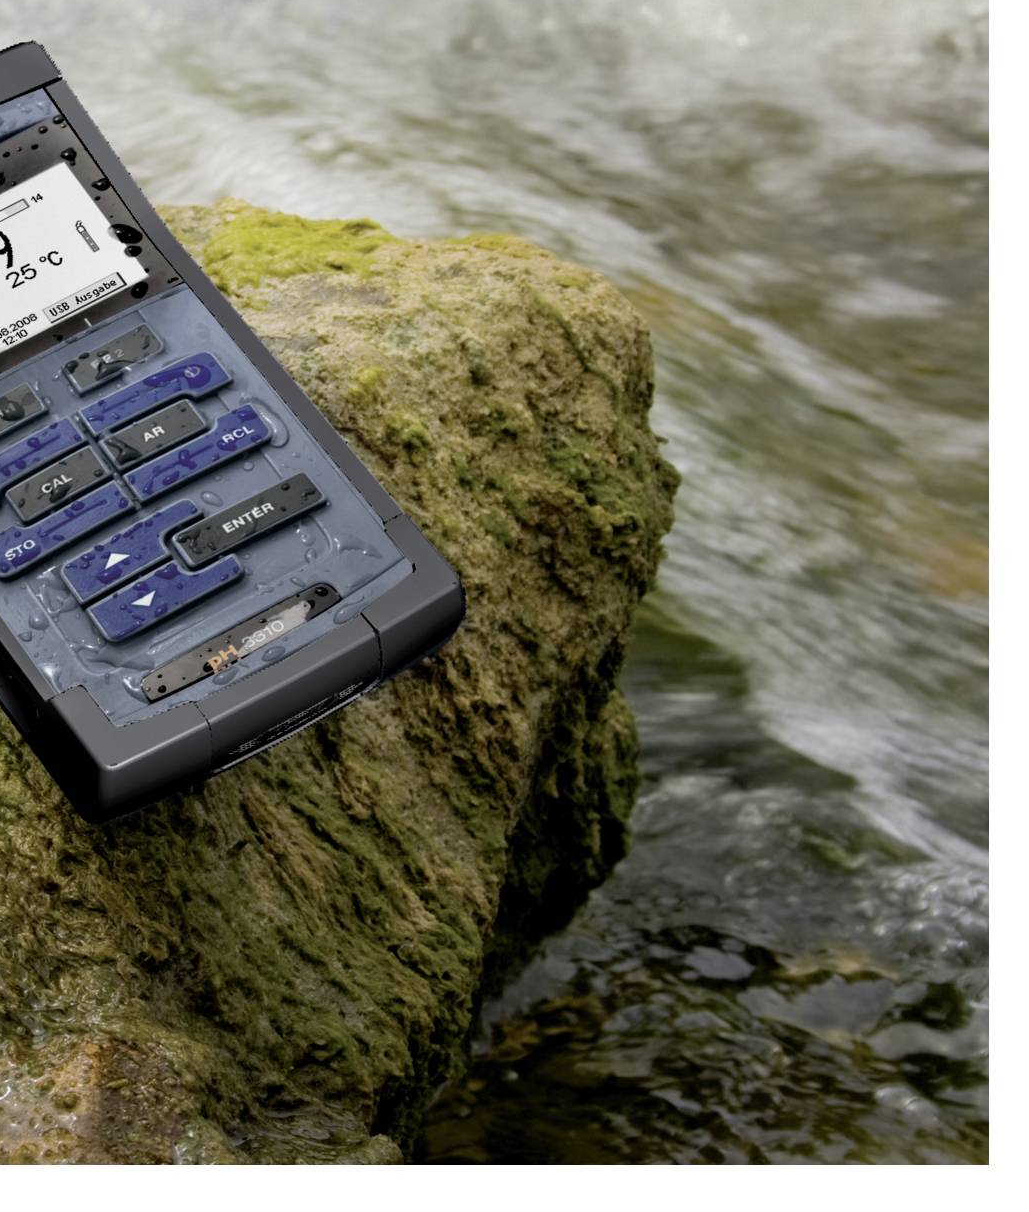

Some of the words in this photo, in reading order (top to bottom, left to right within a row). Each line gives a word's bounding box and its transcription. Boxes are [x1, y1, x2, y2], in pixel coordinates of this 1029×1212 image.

[30, 193, 44, 204] 14
[5, 263, 37, 289] 25
[39, 251, 63, 267] °C
[49, 302, 70, 317] USB
[75, 279, 117, 305] Ausgabe
[2, 329, 28, 346] 12:10
[142, 426, 166, 443] AR
[222, 425, 255, 445] RCL
[41, 472, 73, 495] CAL
[222, 501, 274, 535] ENTER
[4, 538, 36, 562] STO
[207, 644, 239, 674] pH
[241, 619, 285, 650] 3310
